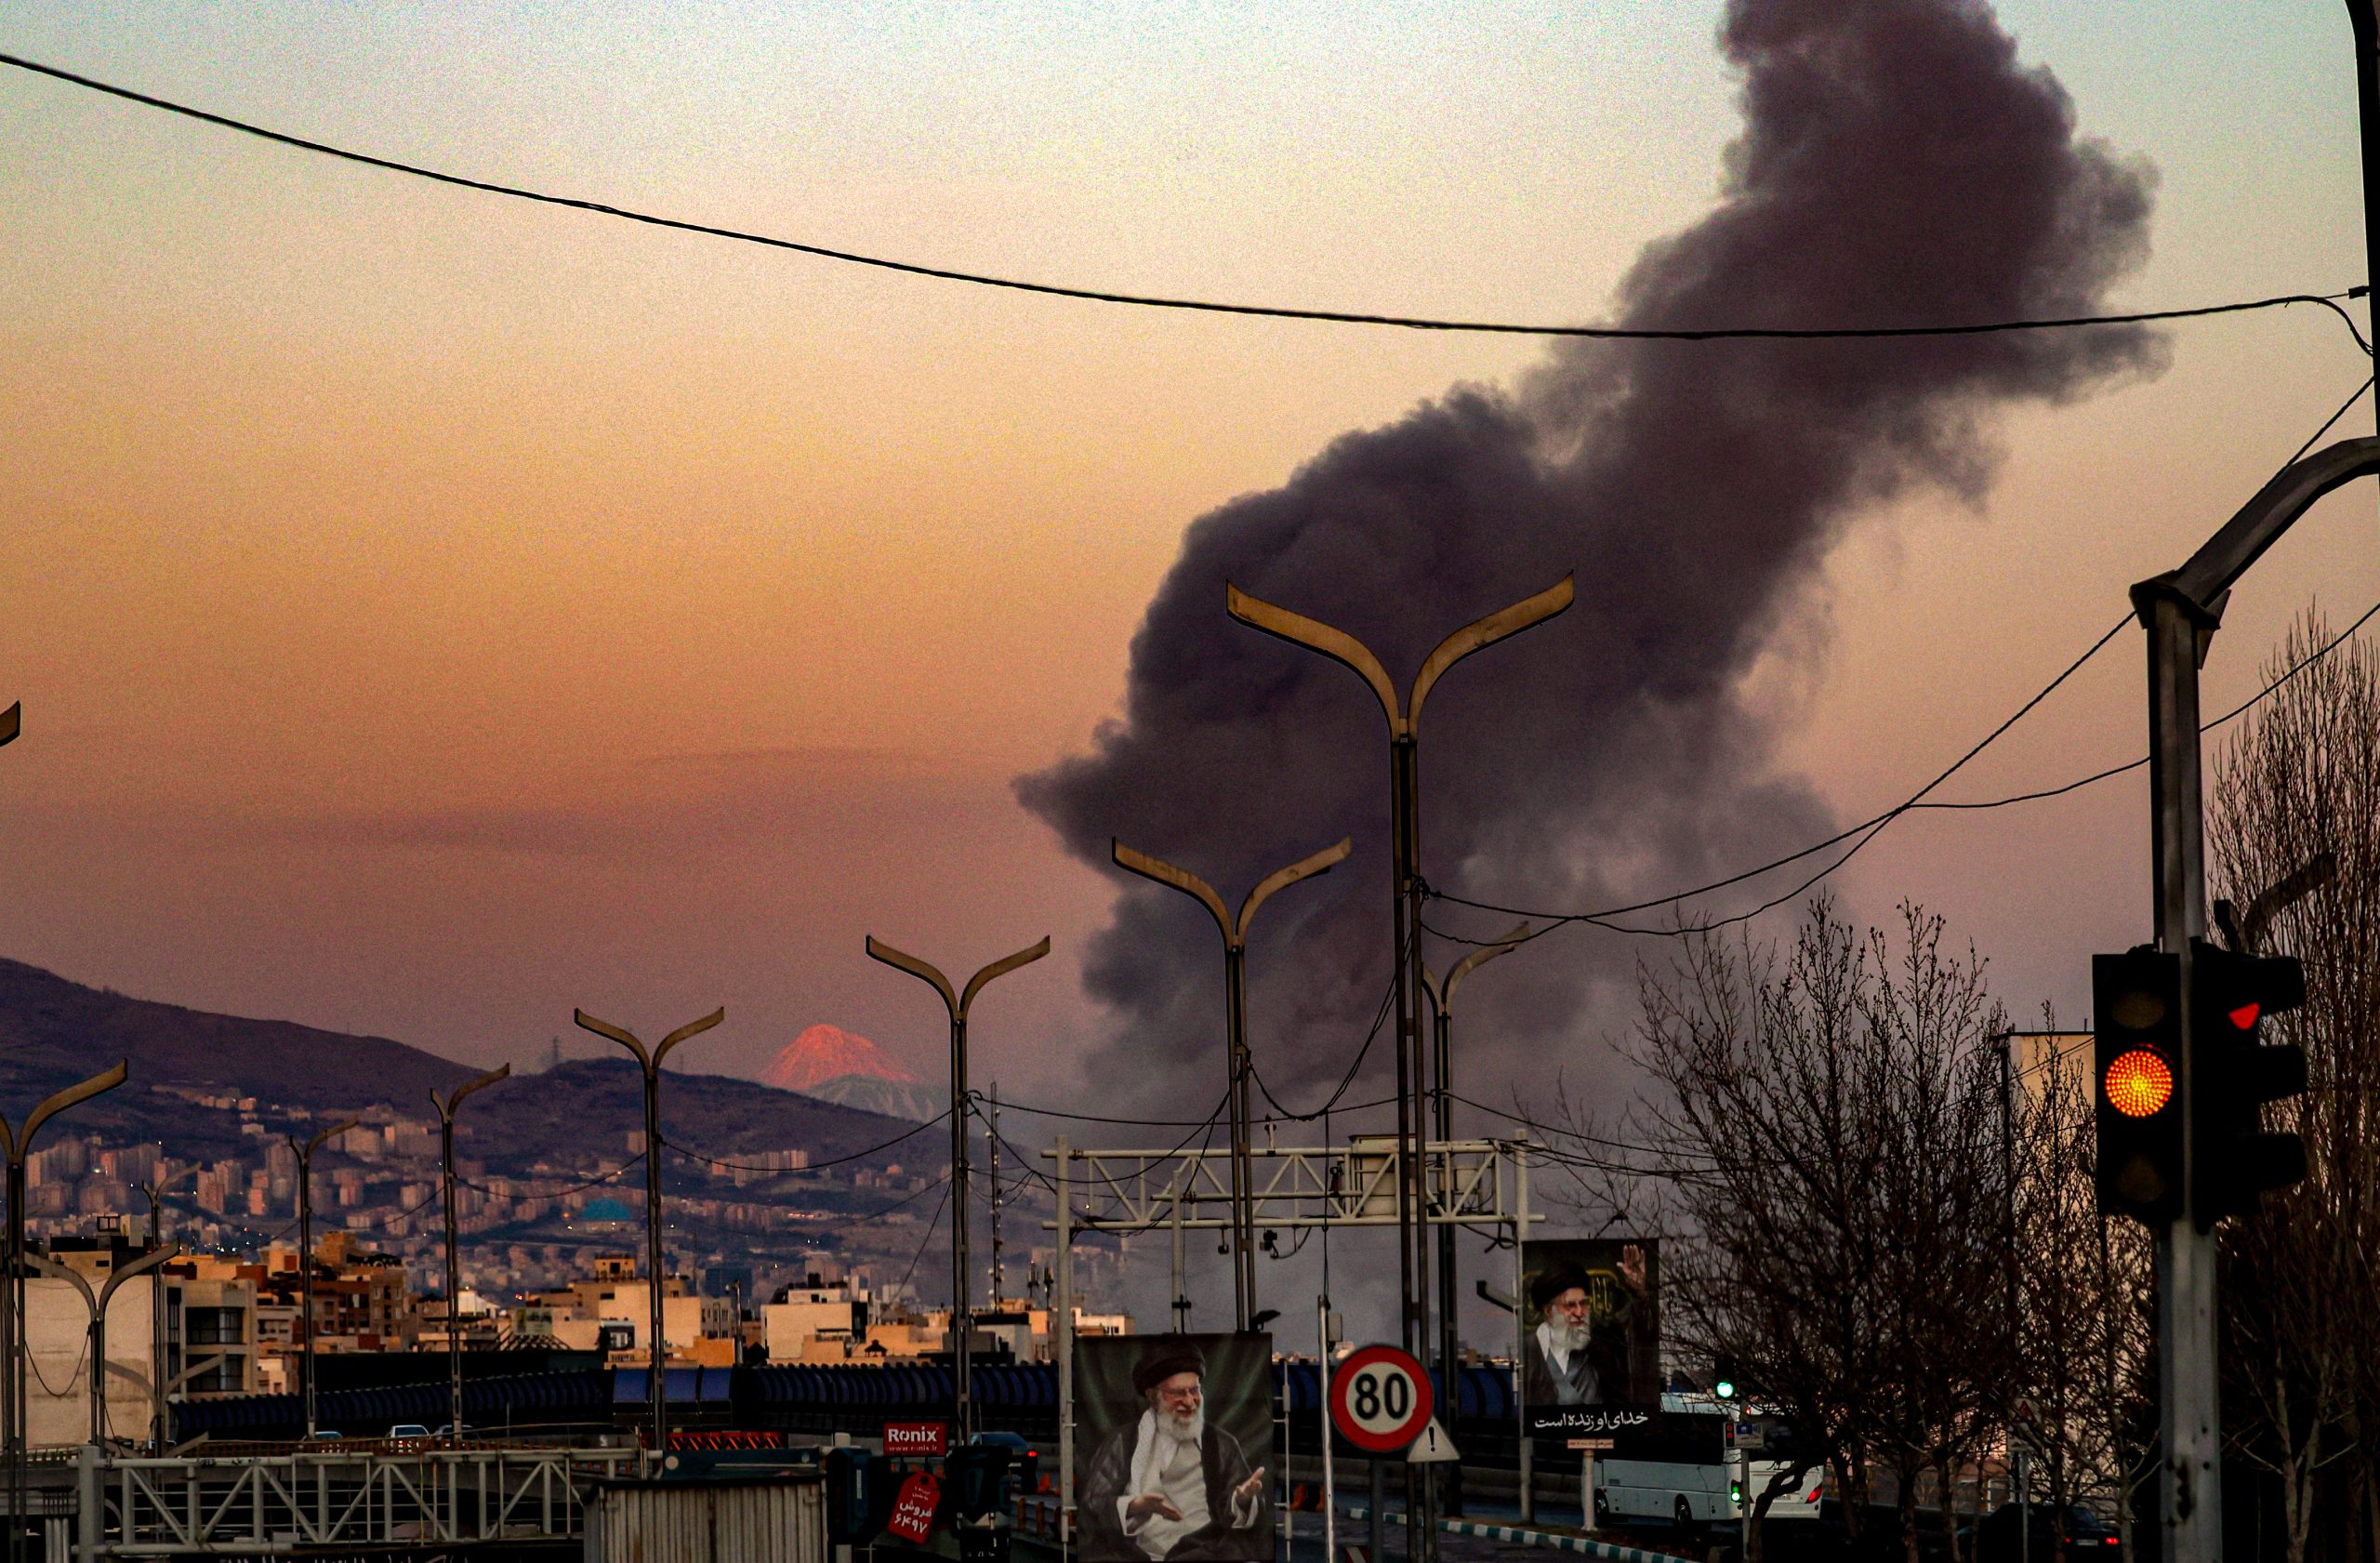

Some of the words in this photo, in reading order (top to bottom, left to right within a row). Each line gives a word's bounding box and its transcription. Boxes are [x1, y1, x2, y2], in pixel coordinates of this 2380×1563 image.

[1355, 1372, 1408, 1421] 80
[1534, 1412, 1567, 1428] است
[1568, 1412, 1594, 1432] زنده
[1593, 1411, 1608, 1432] او
[1607, 1411, 1648, 1430] خدای
[888, 1425, 938, 1442] Ronix
[899, 1499, 932, 1518] فروش
